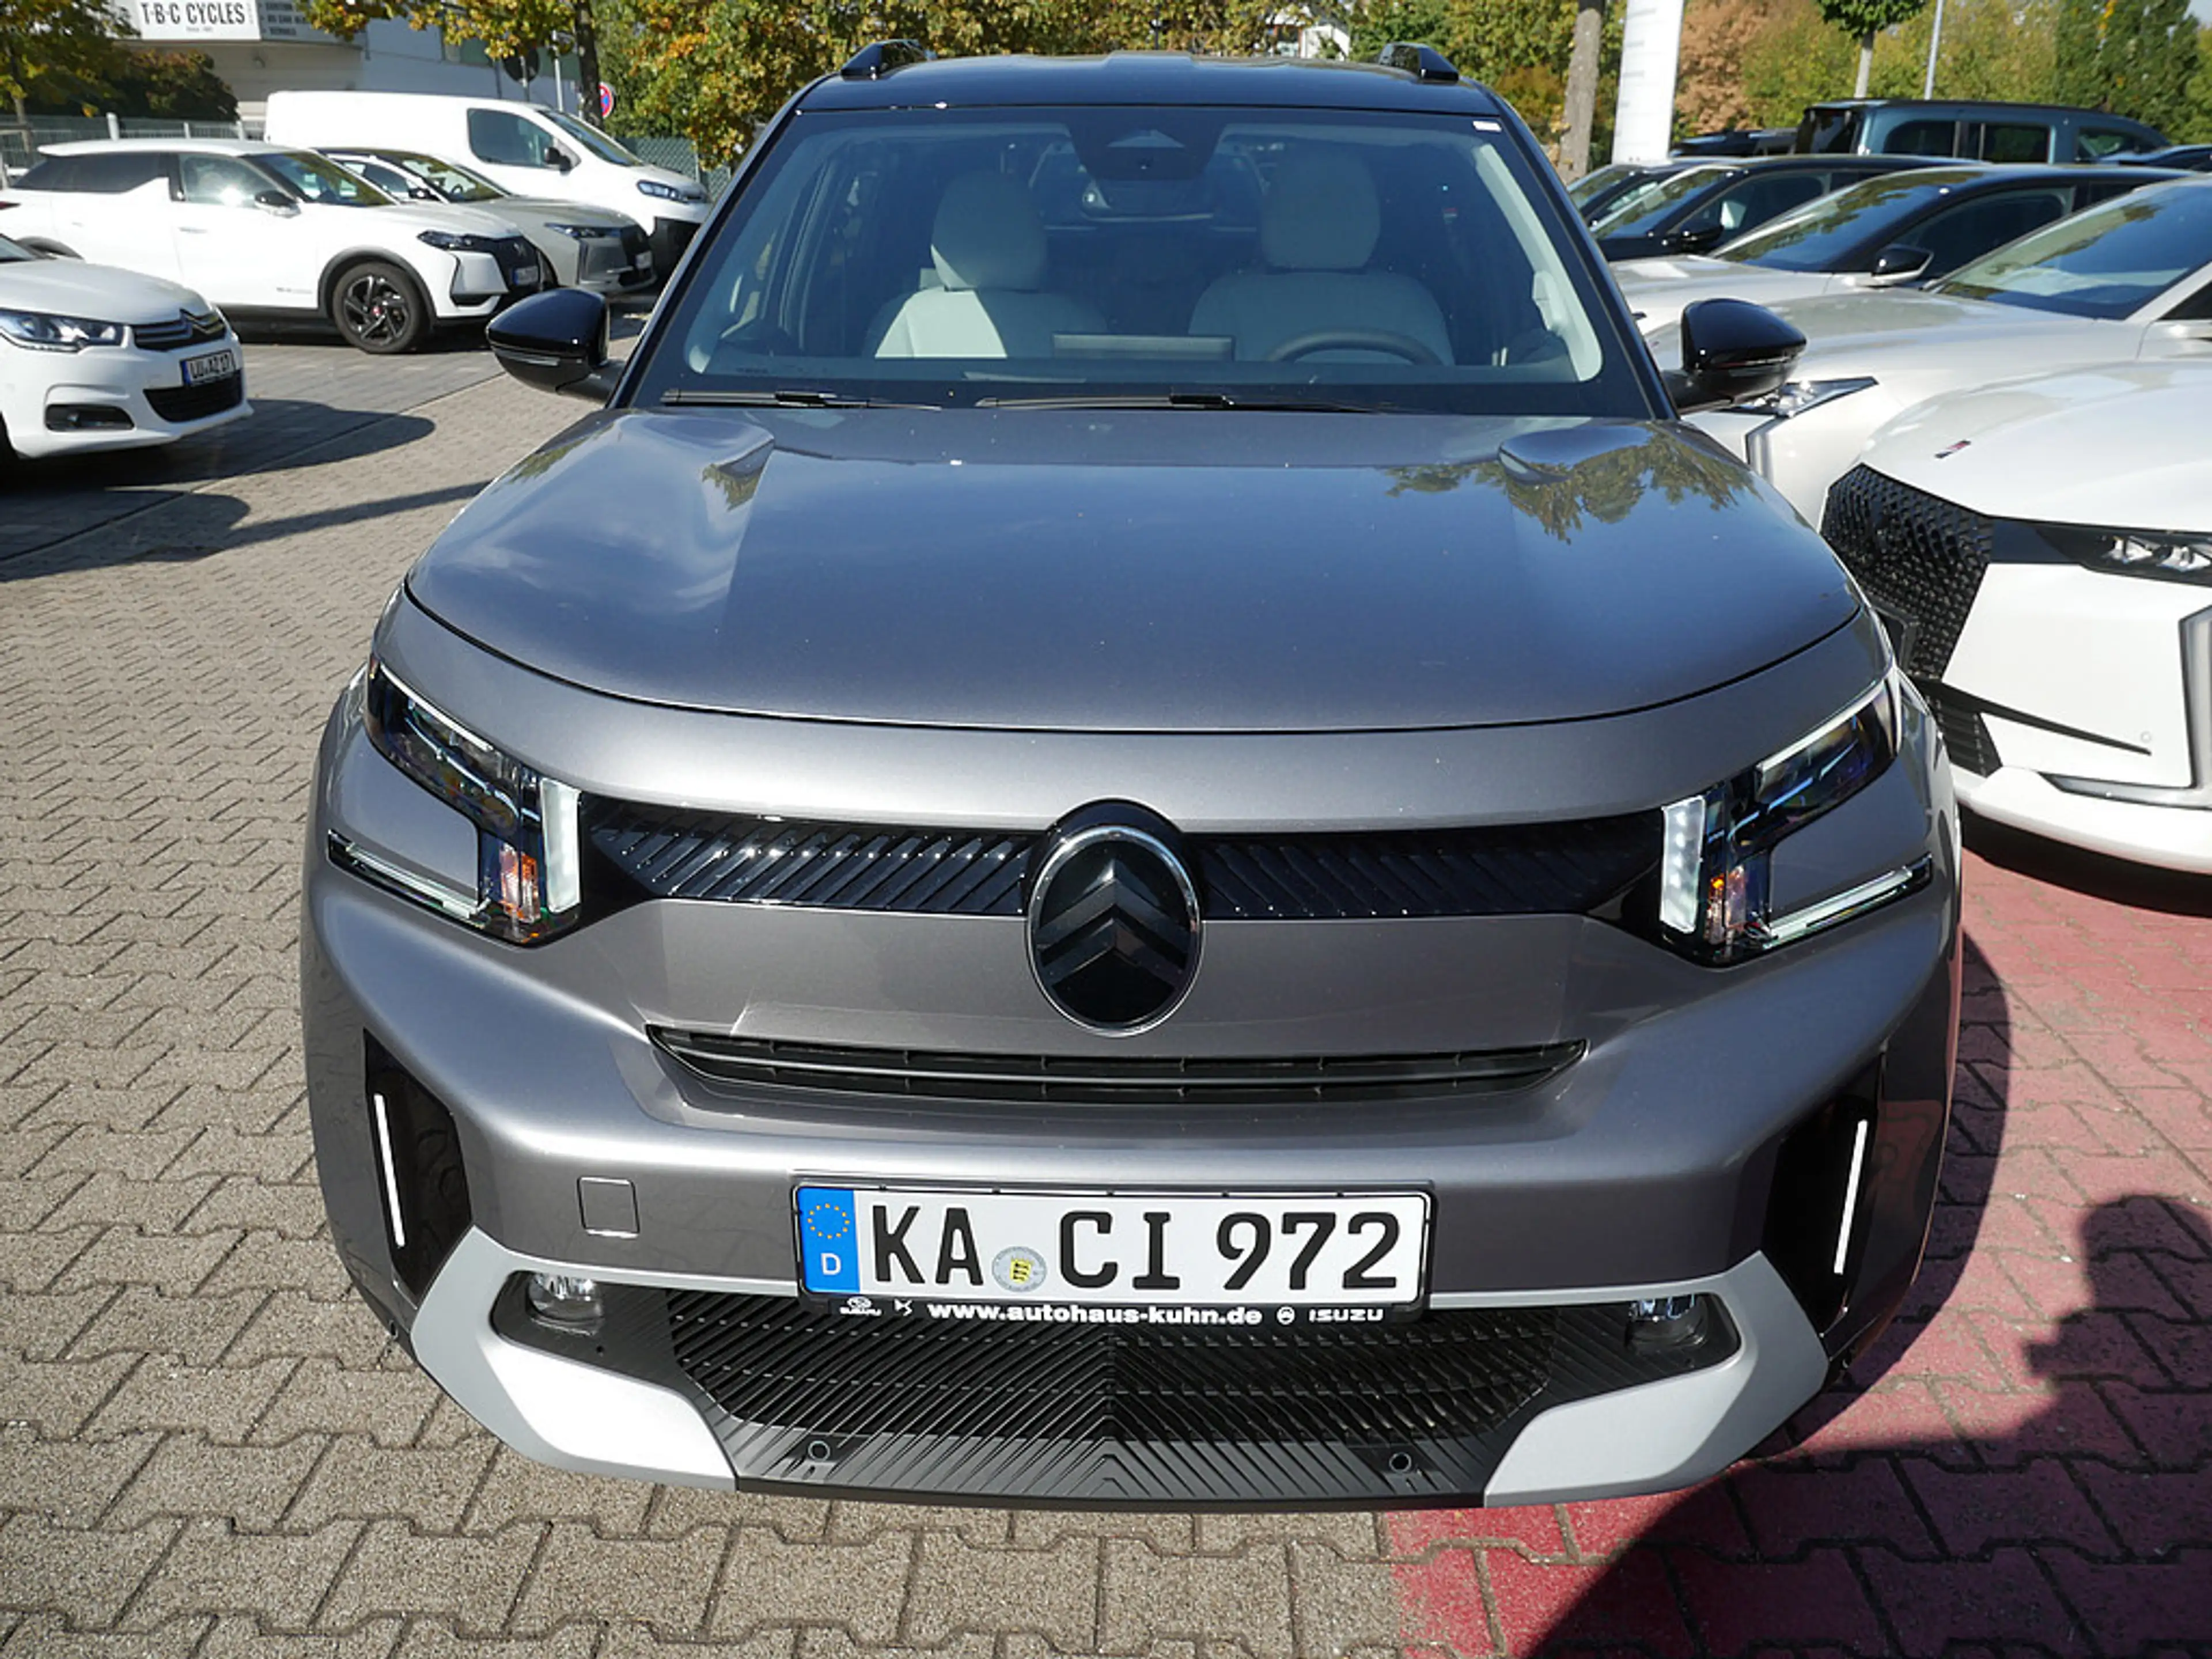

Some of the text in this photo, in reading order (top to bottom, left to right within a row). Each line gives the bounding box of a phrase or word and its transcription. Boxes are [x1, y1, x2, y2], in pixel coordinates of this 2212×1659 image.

[185, 2, 245, 24] CYCLES
[873, 1205, 984, 1286] KA
[1059, 1210, 1180, 1290] CI
[1216, 1211, 1400, 1291] 972
[821, 1252, 842, 1275] D
[927, 1303, 1263, 1325] www.autohaus-kuhn.de
[1308, 1308, 1384, 1323] ISUZU
